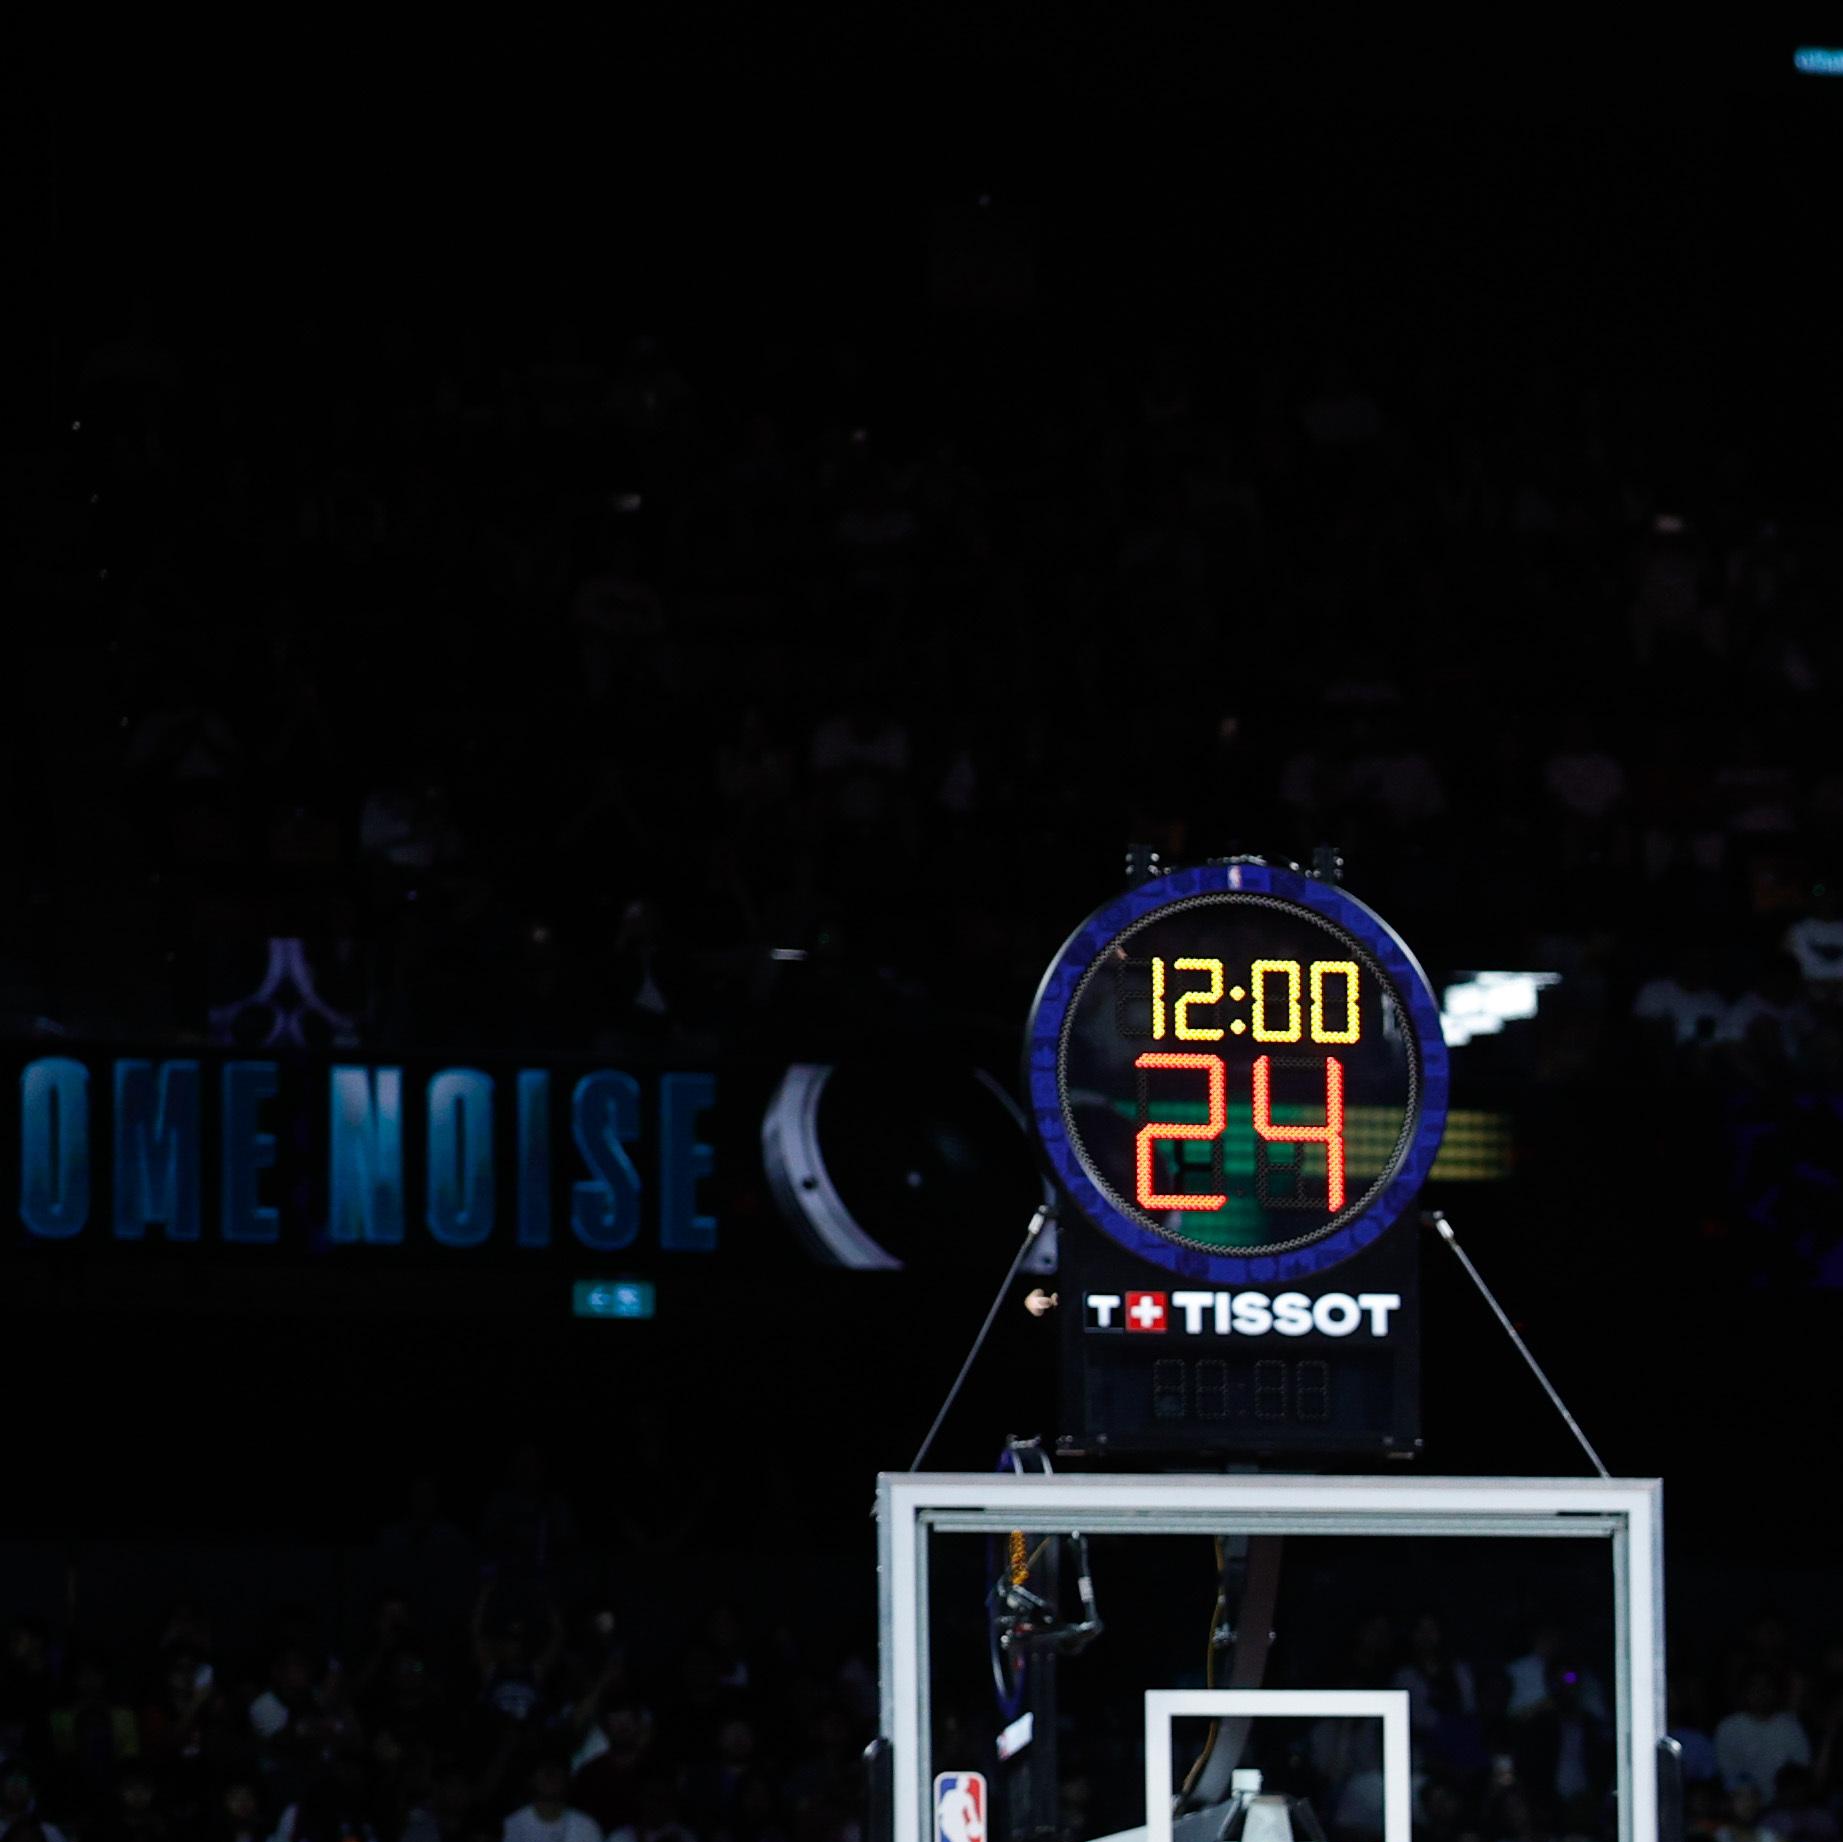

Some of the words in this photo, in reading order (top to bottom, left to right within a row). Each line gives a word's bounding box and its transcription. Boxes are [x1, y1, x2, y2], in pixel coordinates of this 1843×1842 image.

[1152, 957, 1360, 1044] 12:00
[330, 1065, 718, 1251] NOISE
[1135, 1052, 1345, 1211] 24
[1172, 1291, 1400, 1337] TISSOT
